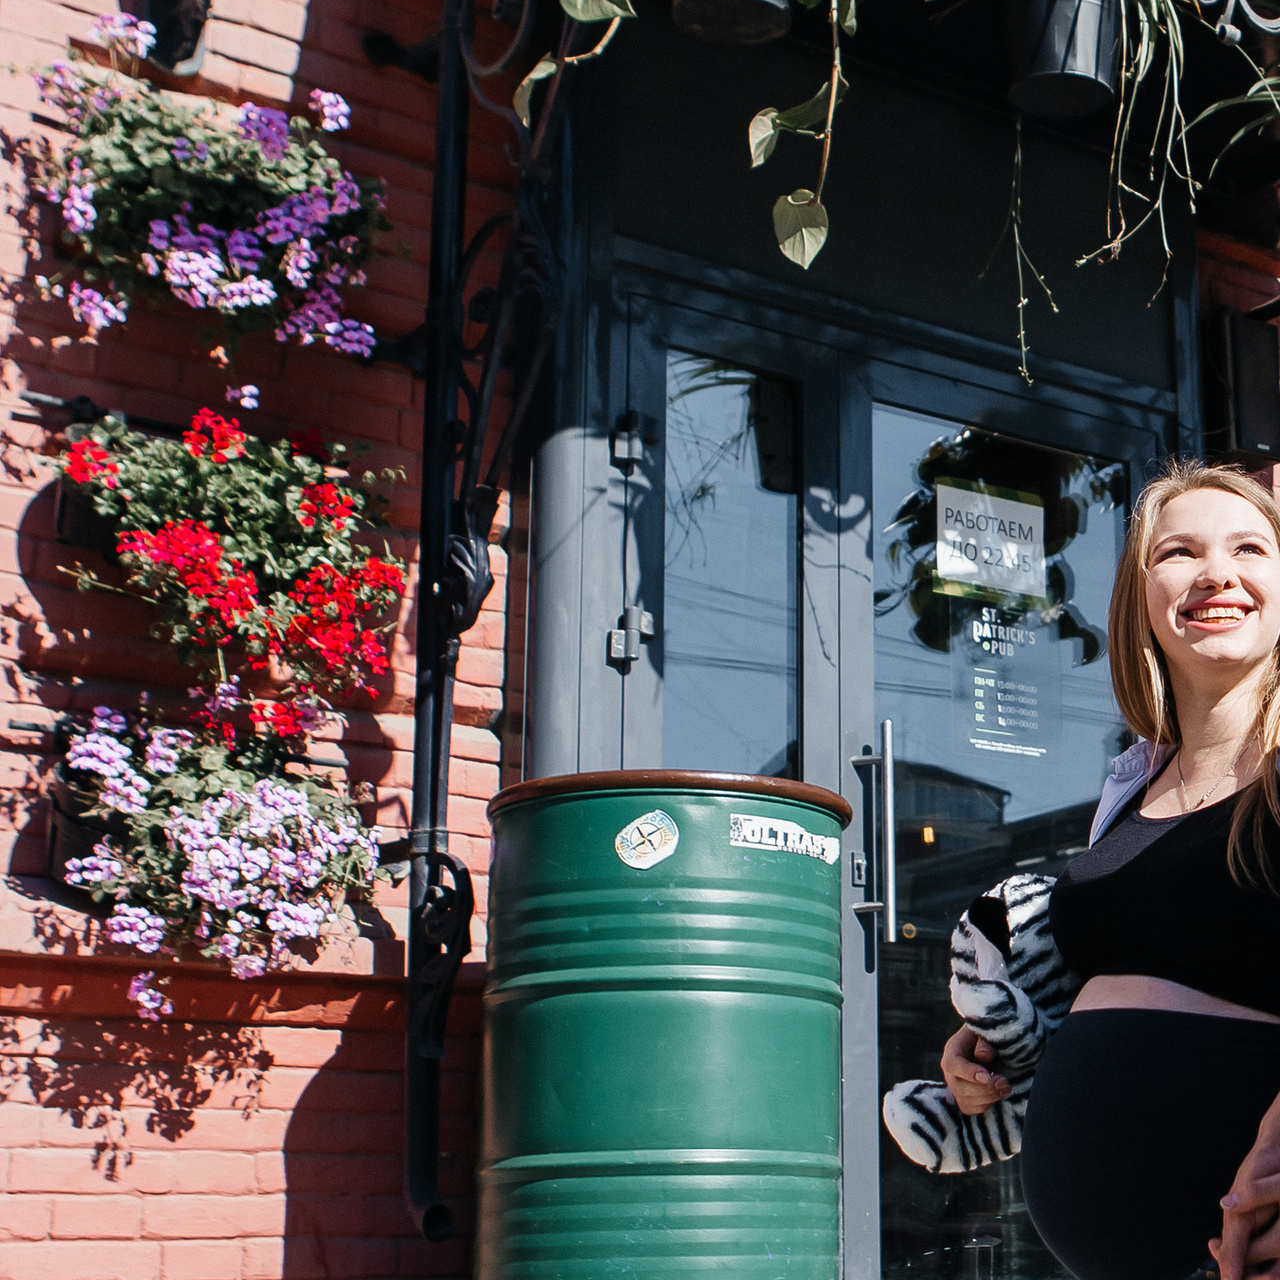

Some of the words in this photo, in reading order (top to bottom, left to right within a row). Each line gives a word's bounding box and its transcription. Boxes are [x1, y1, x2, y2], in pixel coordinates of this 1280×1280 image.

[944, 506, 1034, 542] РАБОТАЕМ
[949, 539, 978, 563] ДО
[981, 606, 1002, 623] ST.
[972, 620, 1036, 645] PATRICK'S
[990, 640, 1015, 657] PUB
